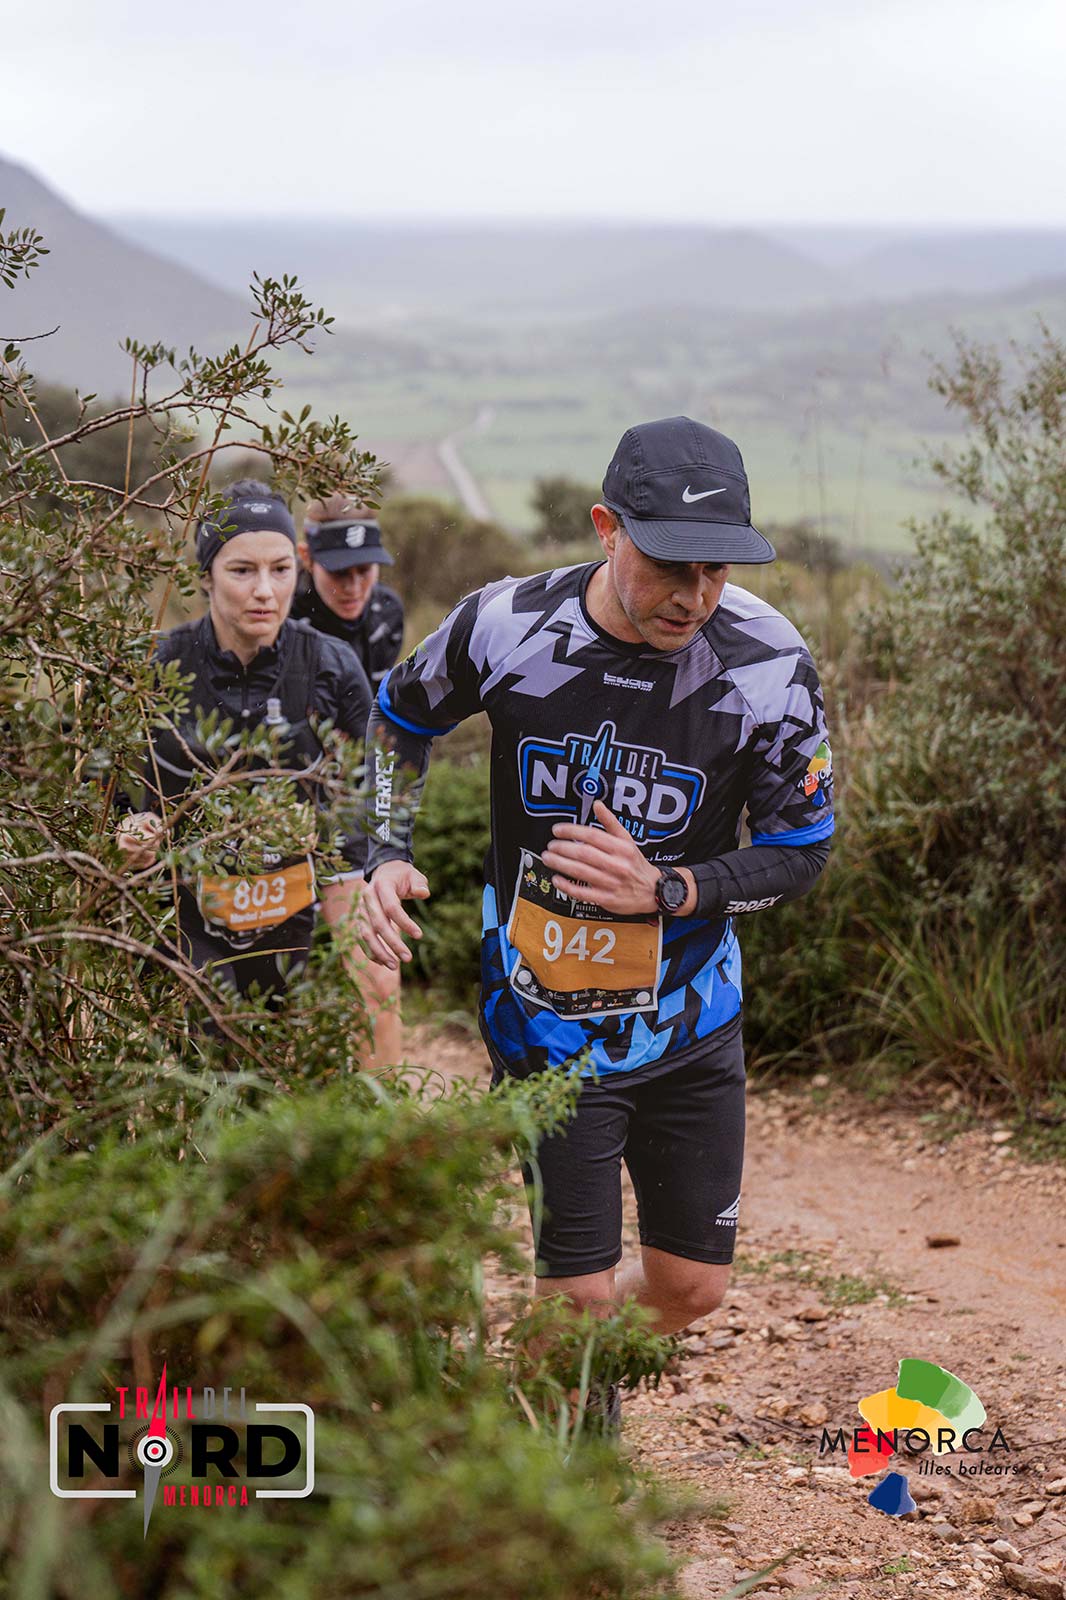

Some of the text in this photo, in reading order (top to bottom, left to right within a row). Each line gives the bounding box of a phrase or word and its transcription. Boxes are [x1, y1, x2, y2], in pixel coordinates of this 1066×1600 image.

[531, 760, 688, 824] NORD
[233, 876, 286, 910] 803
[724, 893, 784, 913] ERREX
[543, 919, 617, 965] 942
[715, 1219, 735, 1227] NIKE
